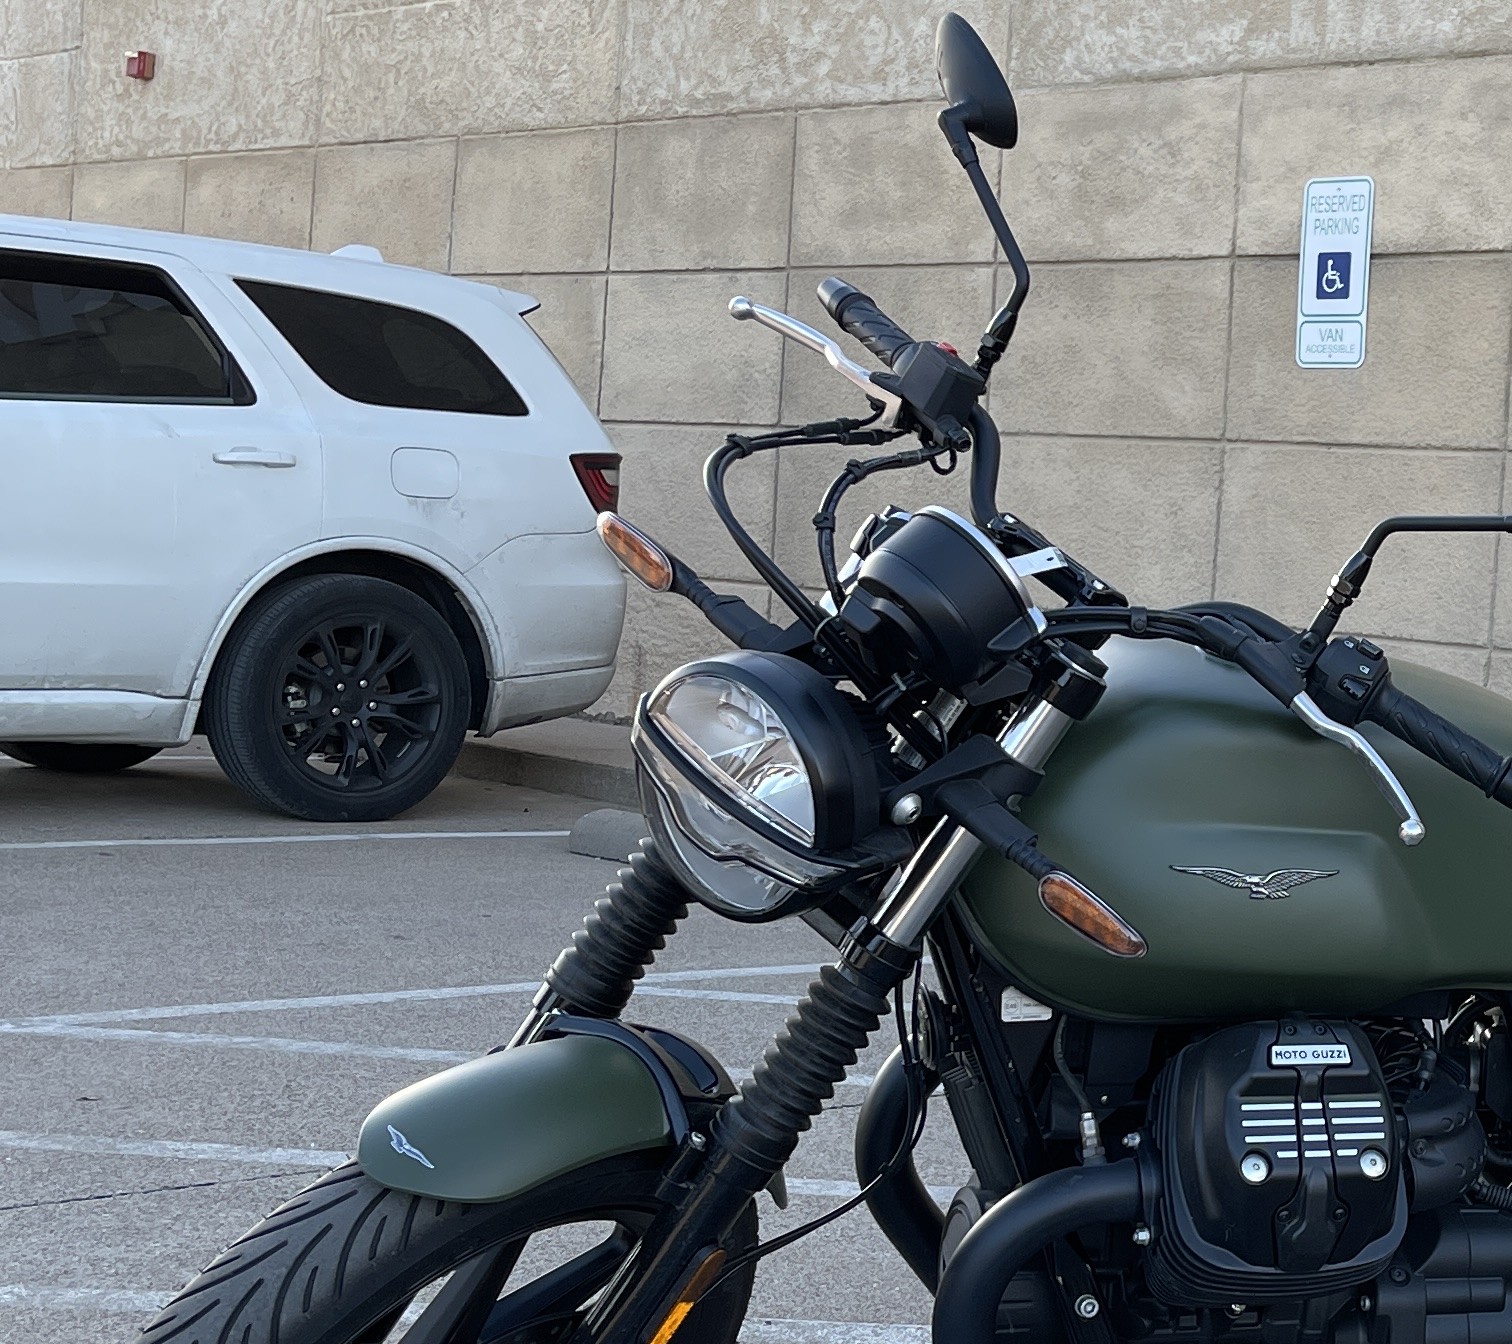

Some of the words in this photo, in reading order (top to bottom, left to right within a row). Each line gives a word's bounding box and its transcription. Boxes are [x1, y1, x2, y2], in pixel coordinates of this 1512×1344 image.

[1310, 194, 1366, 214] RESERVED
[1313, 217, 1360, 235] PARKING
[1319, 328, 1344, 342] VAN
[1305, 344, 1355, 354] ACCESSIBLE
[1274, 1050, 1307, 1060] MOTO
[1312, 1049, 1346, 1059] GUZZI
